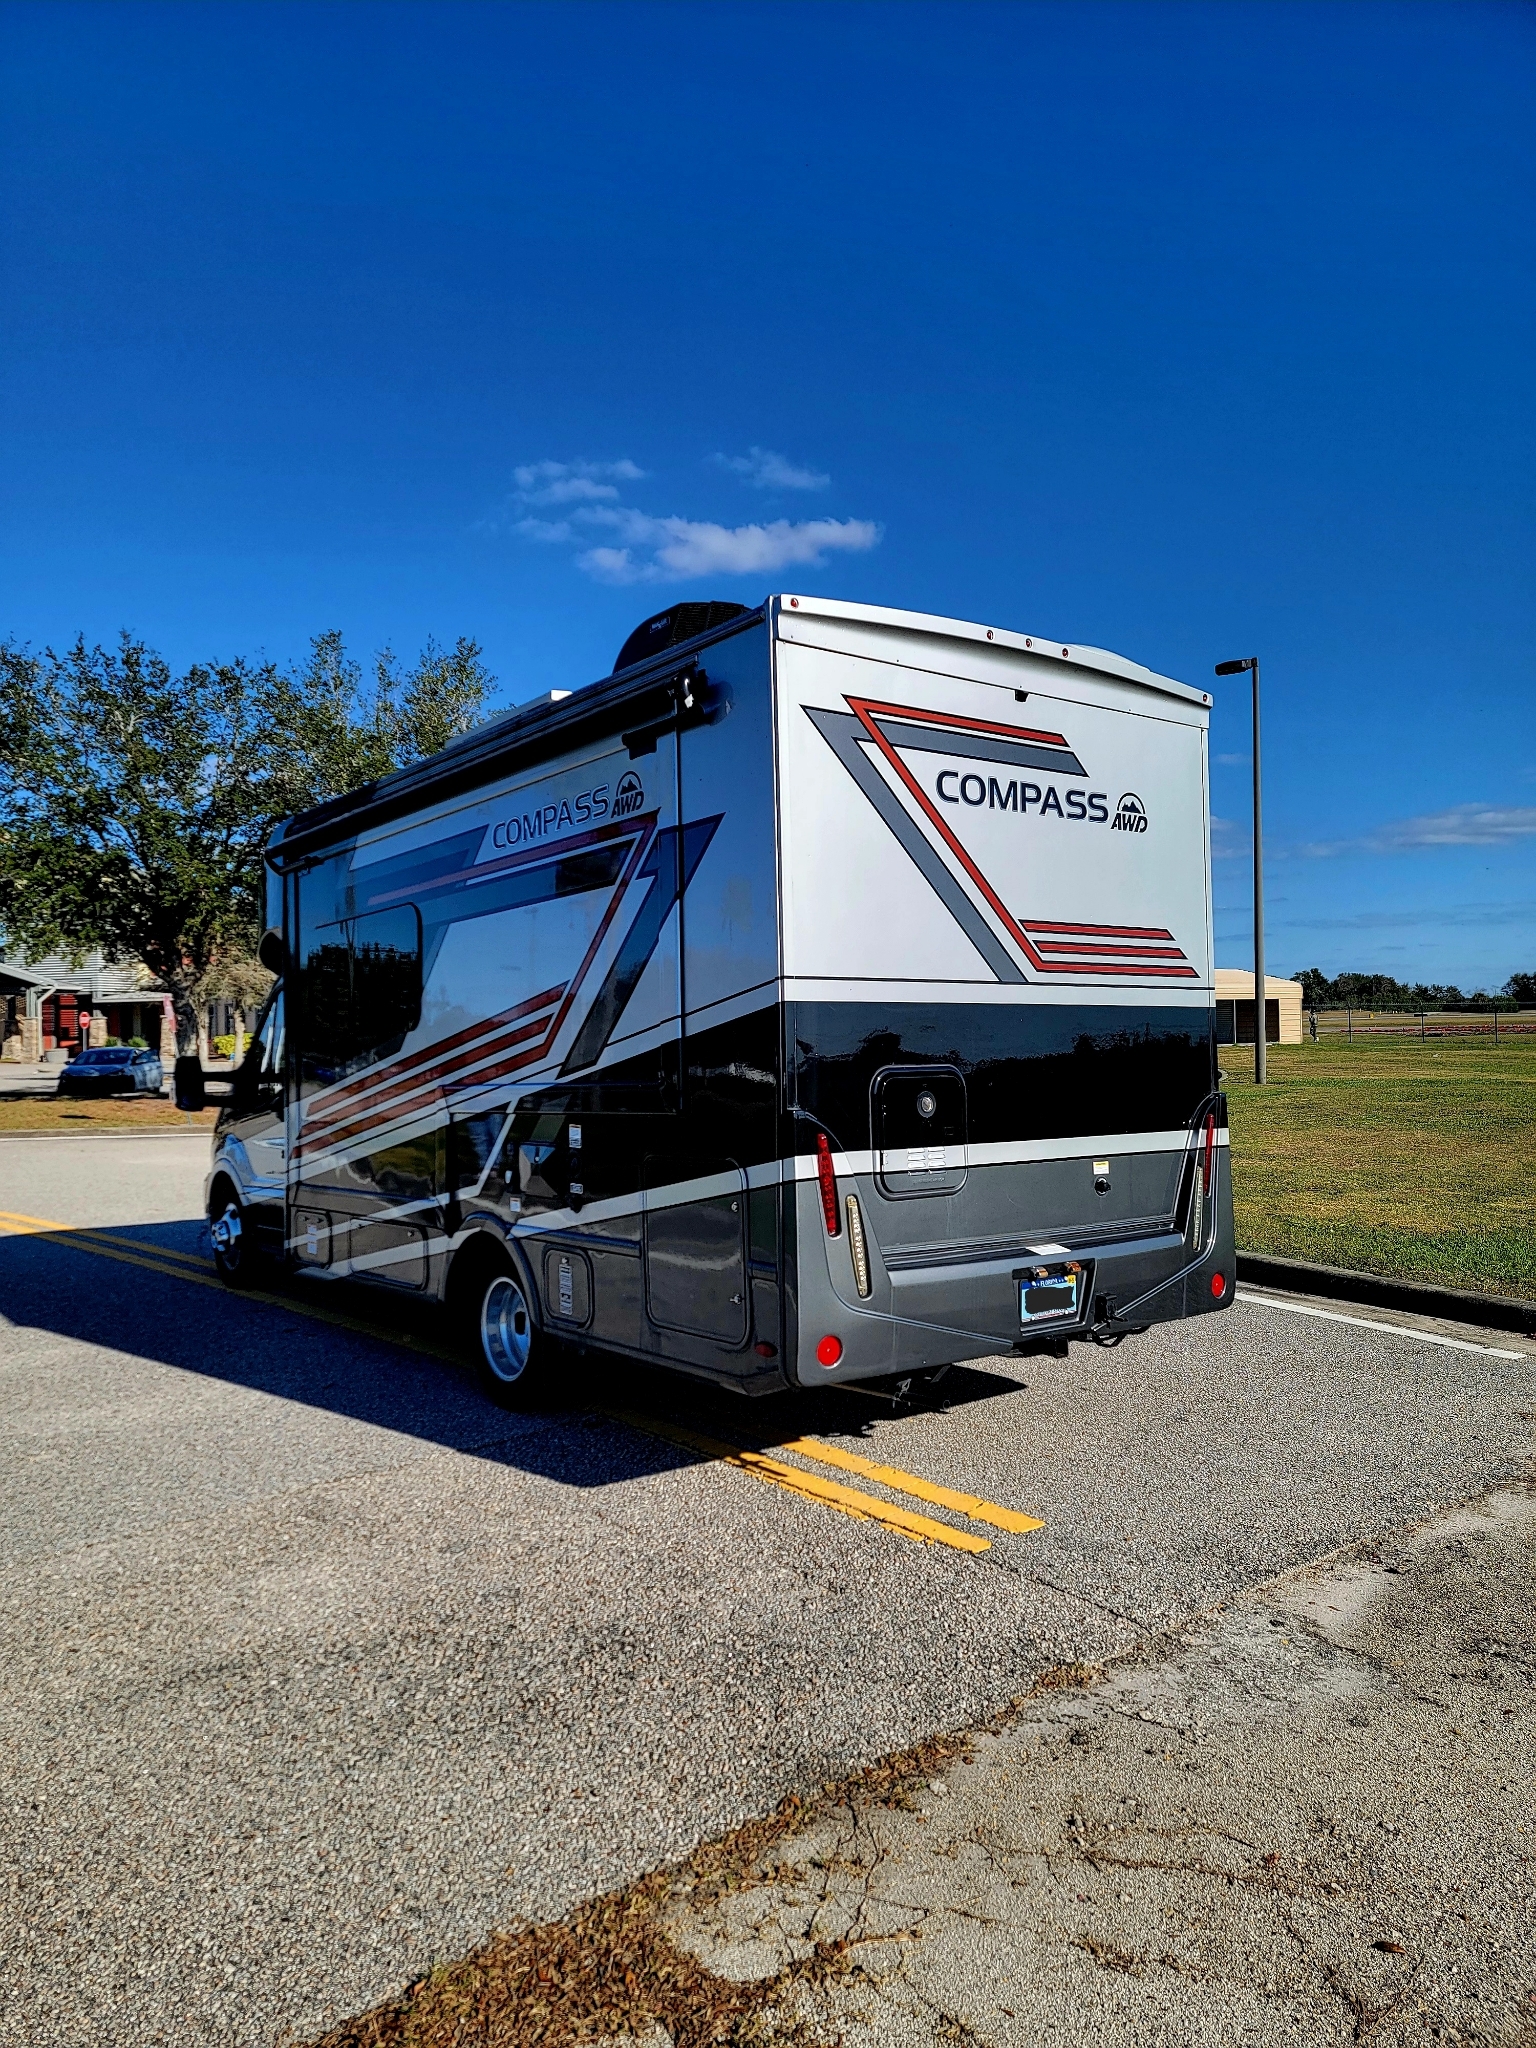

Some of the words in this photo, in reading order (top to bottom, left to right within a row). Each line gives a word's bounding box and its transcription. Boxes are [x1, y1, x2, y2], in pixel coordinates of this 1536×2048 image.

[492, 785, 609, 848] COMPASS
[611, 791, 644, 818] AWD
[937, 770, 1109, 822] COMPASS
[1111, 812, 1148, 833] AWD
